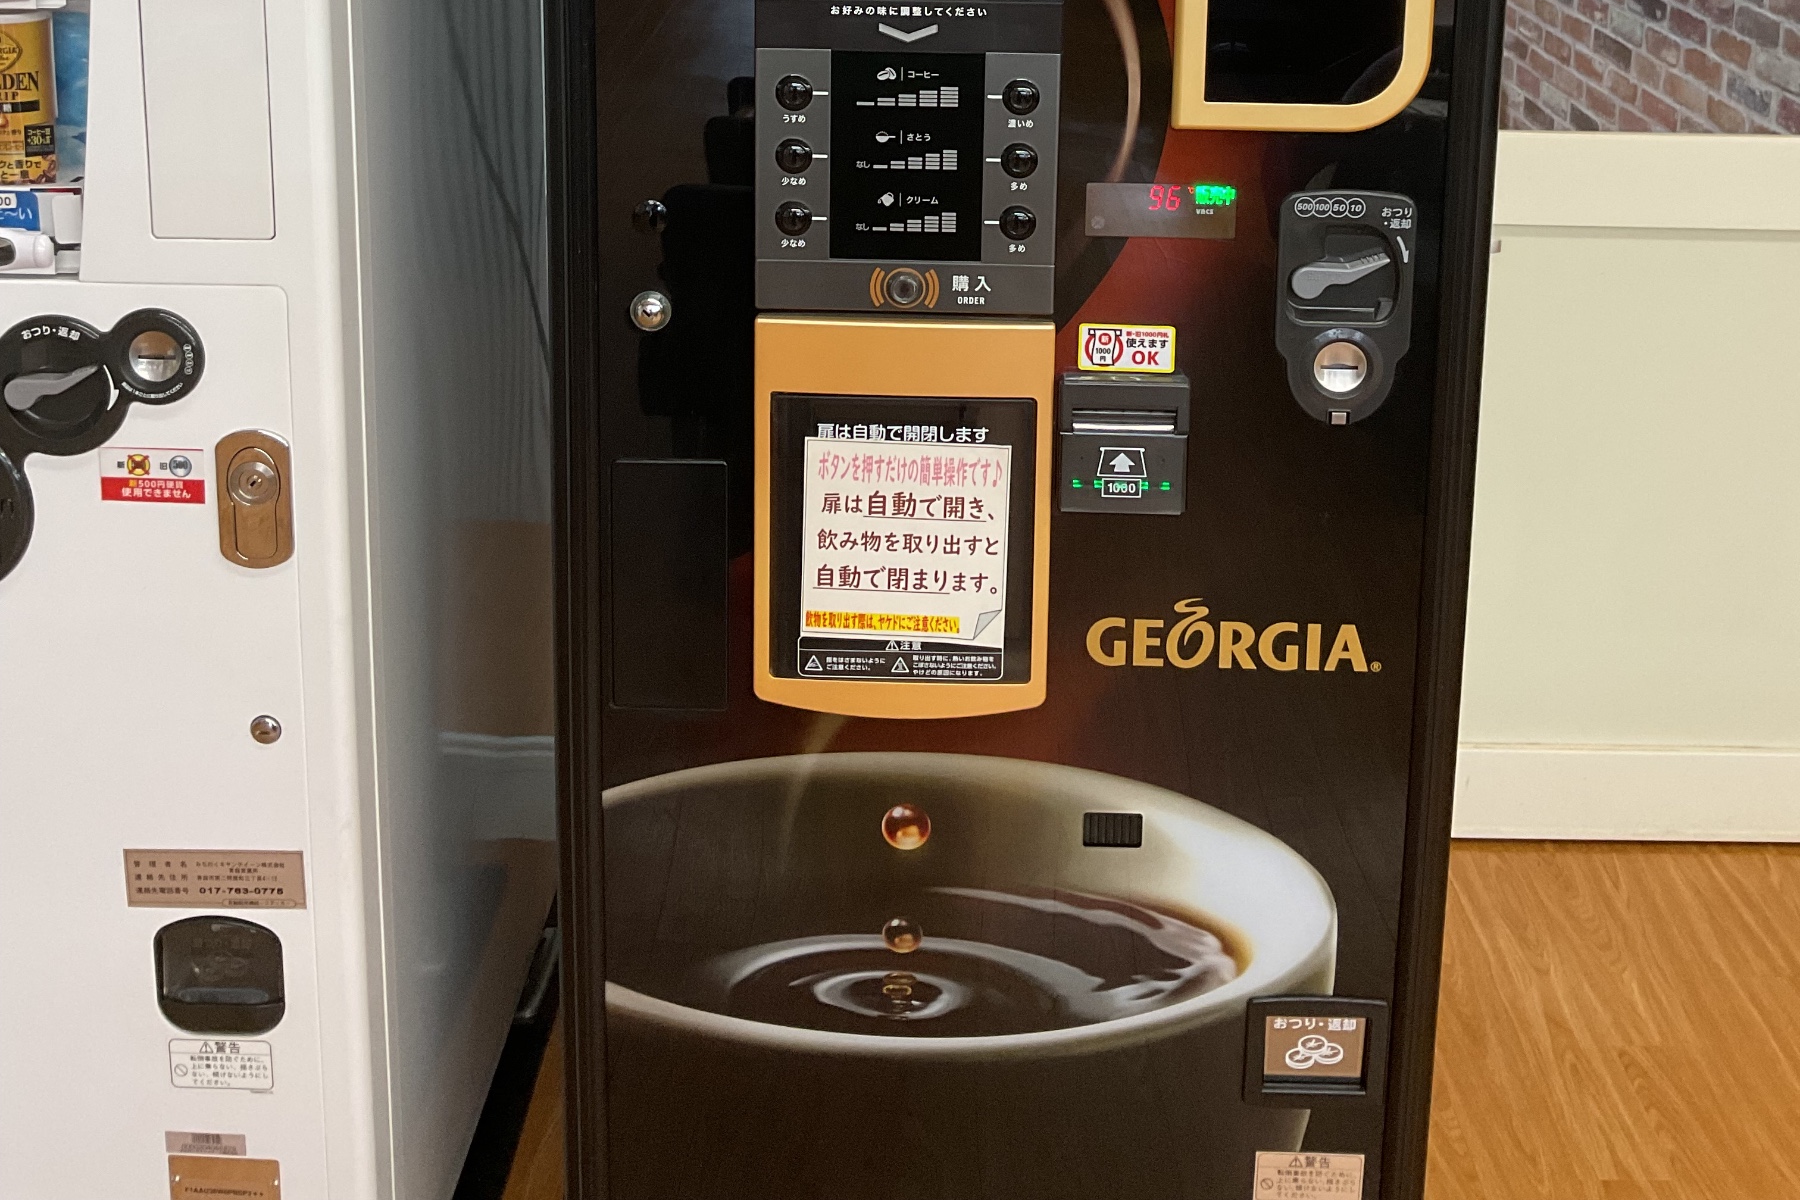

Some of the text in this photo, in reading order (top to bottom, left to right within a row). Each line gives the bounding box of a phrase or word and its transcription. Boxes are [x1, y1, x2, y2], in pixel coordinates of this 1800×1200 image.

[830, 5, 987, 17] お好みの味に調整してください
[907, 70, 940, 79] コーヒー
[0, 71, 39, 92] DEN
[782, 114, 806, 124] うすめ
[1007, 118, 1034, 128] 濃いめ
[906, 133, 931, 142] さとう
[856, 160, 871, 169] なし
[781, 176, 806, 186] 少なめ
[1010, 181, 1028, 191] 多め
[906, 195, 939, 205] クリーム
[1149, 186, 1181, 211] 96
[1297, 203, 1313, 211] 500
[1333, 204, 1346, 212] 50
[1350, 204, 1362, 212] 10
[1381, 206, 1413, 218] おつり
[855, 223, 870, 232] なし
[781, 238, 806, 248] 少なめ
[1008, 244, 1026, 254] 多め
[951, 275, 992, 293] 購入
[957, 296, 985, 305] ORDER
[1126, 338, 1169, 349] 使えます
[1096, 347, 1111, 355] 1000
[1131, 350, 1159, 366] OK
[817, 423, 989, 443] 扉は自動で開閉します
[121, 487, 191, 499] 使用できません
[1107, 483, 1136, 494] 1000
[821, 490, 995, 521] 扉は自動で開き、
[817, 528, 999, 556] 飲み物を取り出すと
[816, 564, 998, 595] 自動で閉まります。
[900, 641, 922, 651] 注意
[1273, 1017, 1357, 1032] おつり・返却
[215, 1041, 241, 1054] 警告
